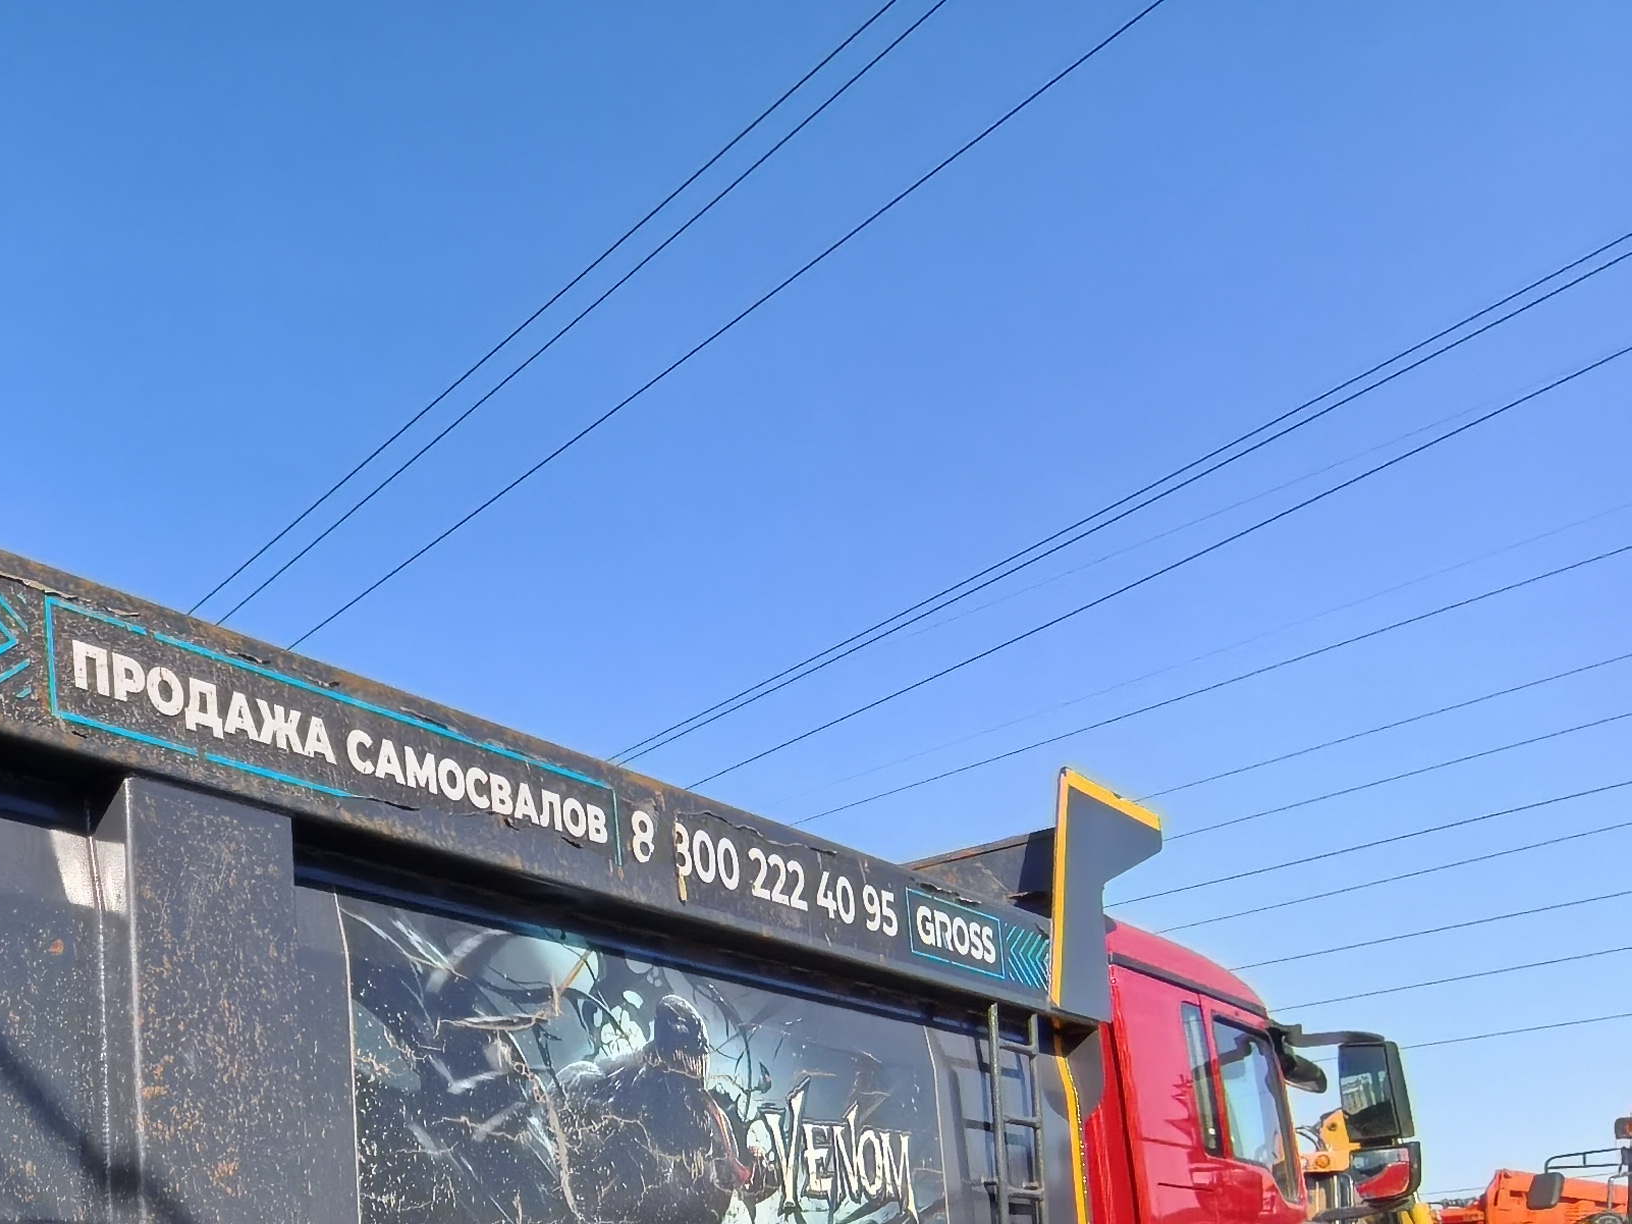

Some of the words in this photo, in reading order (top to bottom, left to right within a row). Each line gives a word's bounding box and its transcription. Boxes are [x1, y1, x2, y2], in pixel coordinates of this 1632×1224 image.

[72, 640, 337, 765] ПРОДАЖА
[346, 729, 608, 844] САМОСВАЛОВ
[631, 810, 655, 863] 8
[748, 847, 809, 912] 222
[816, 871, 856, 925] 40
[862, 884, 899, 938] 95
[916, 905, 996, 964] GROSS
